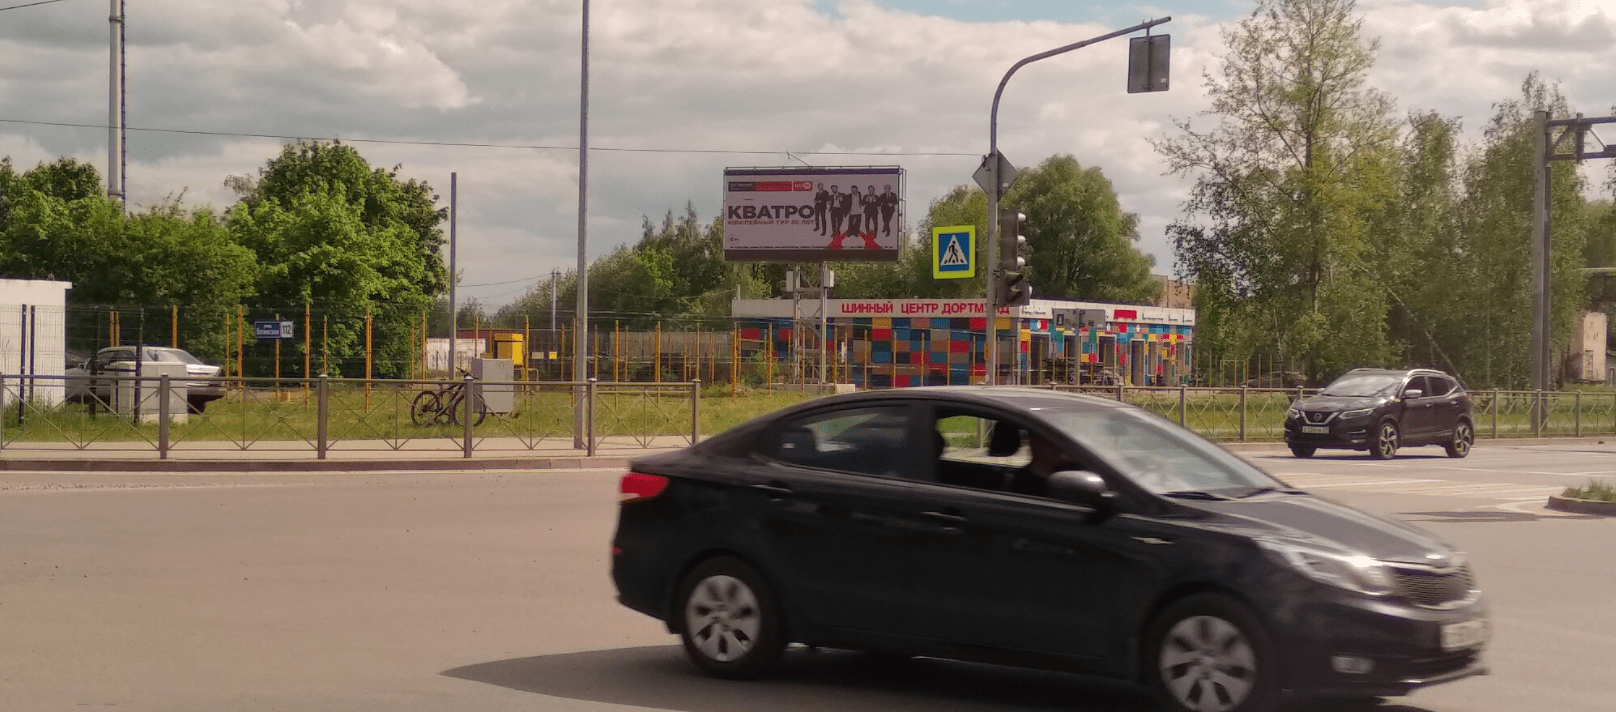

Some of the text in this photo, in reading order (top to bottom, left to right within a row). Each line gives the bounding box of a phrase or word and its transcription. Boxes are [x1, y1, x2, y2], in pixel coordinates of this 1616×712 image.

[728, 205, 815, 219] КВАТРО
[841, 301, 893, 314] ШИННЫЙ
[901, 303, 939, 315] ЦЕНТР
[941, 303, 1010, 315] ДОРТМД
